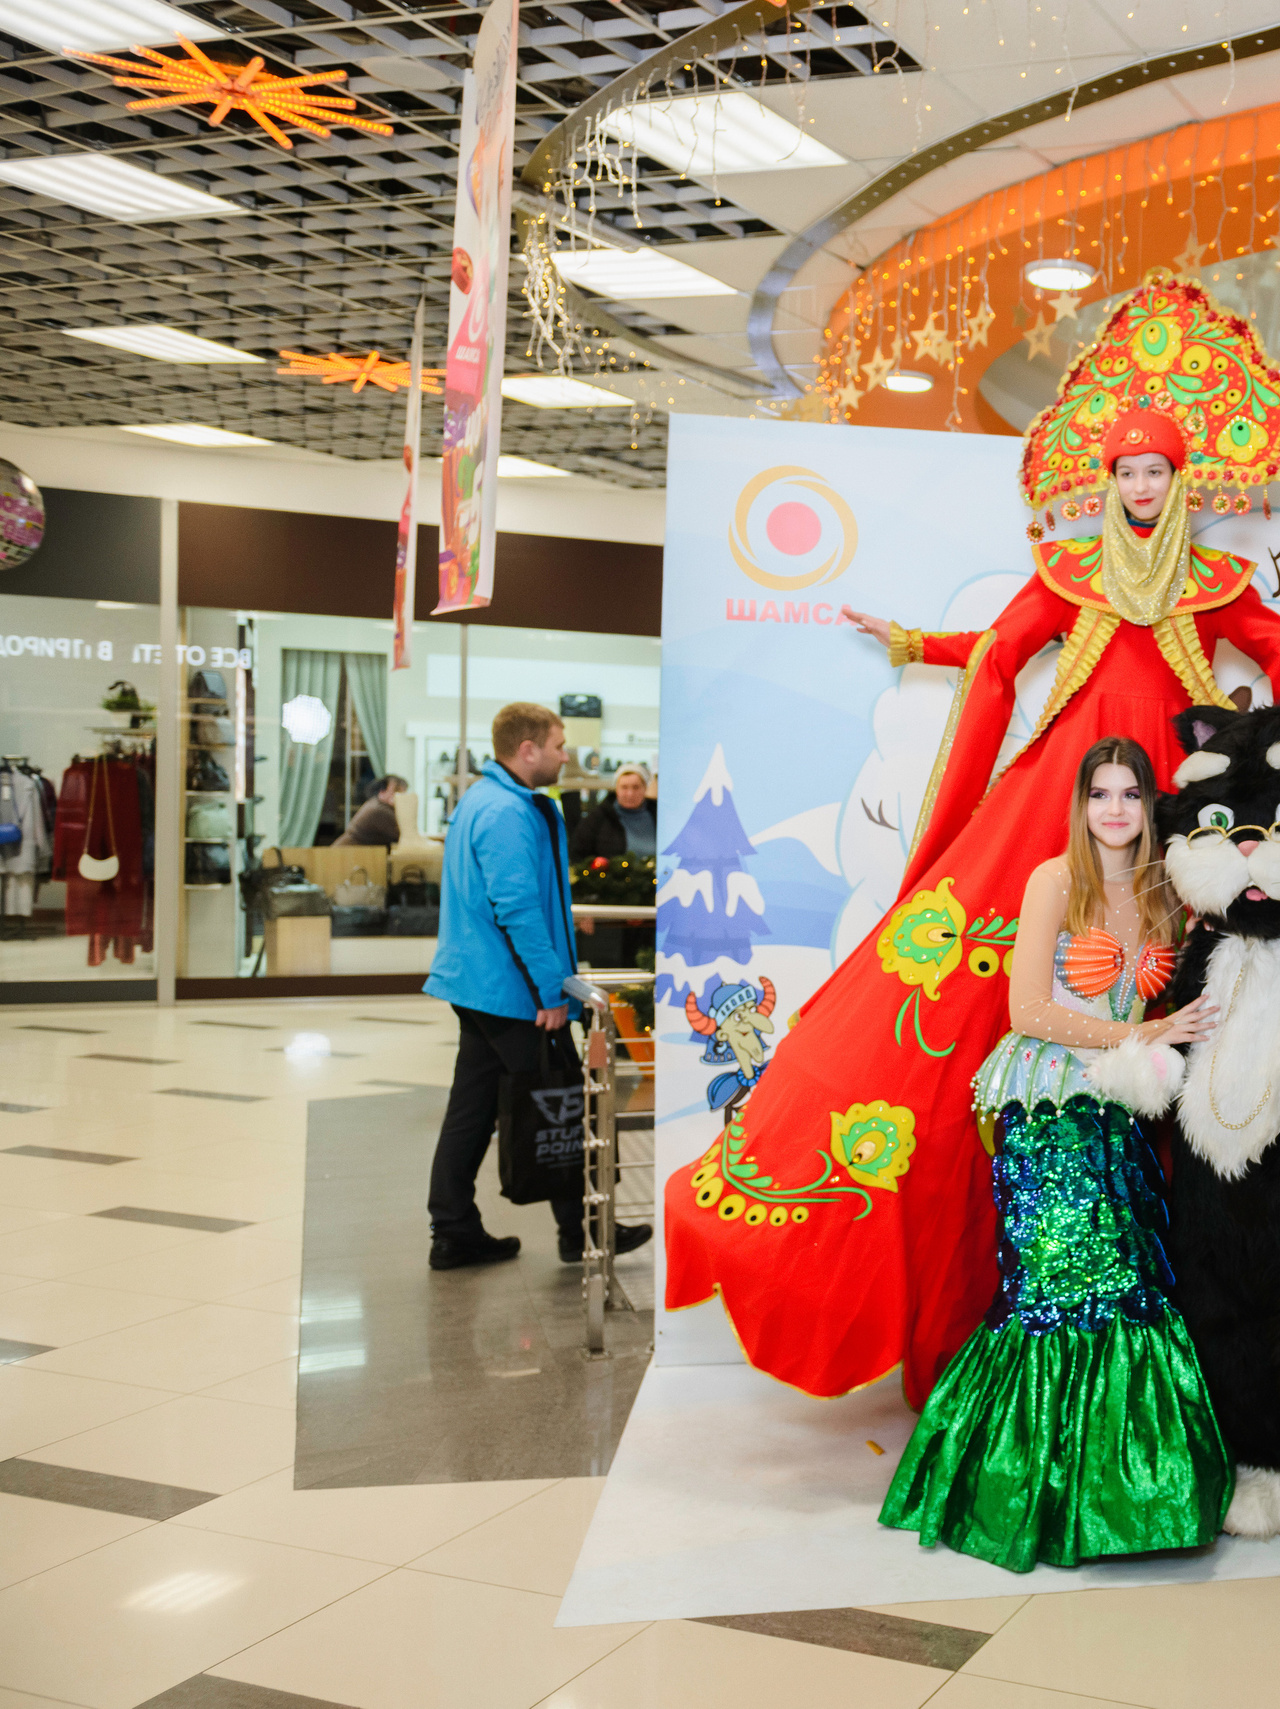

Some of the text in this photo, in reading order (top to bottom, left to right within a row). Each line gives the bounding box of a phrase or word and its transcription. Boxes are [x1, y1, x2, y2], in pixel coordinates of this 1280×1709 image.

[724, 598, 857, 627] ШАМСА
[534, 1124, 584, 1143] STUF
[535, 1138, 584, 1157] POIN
